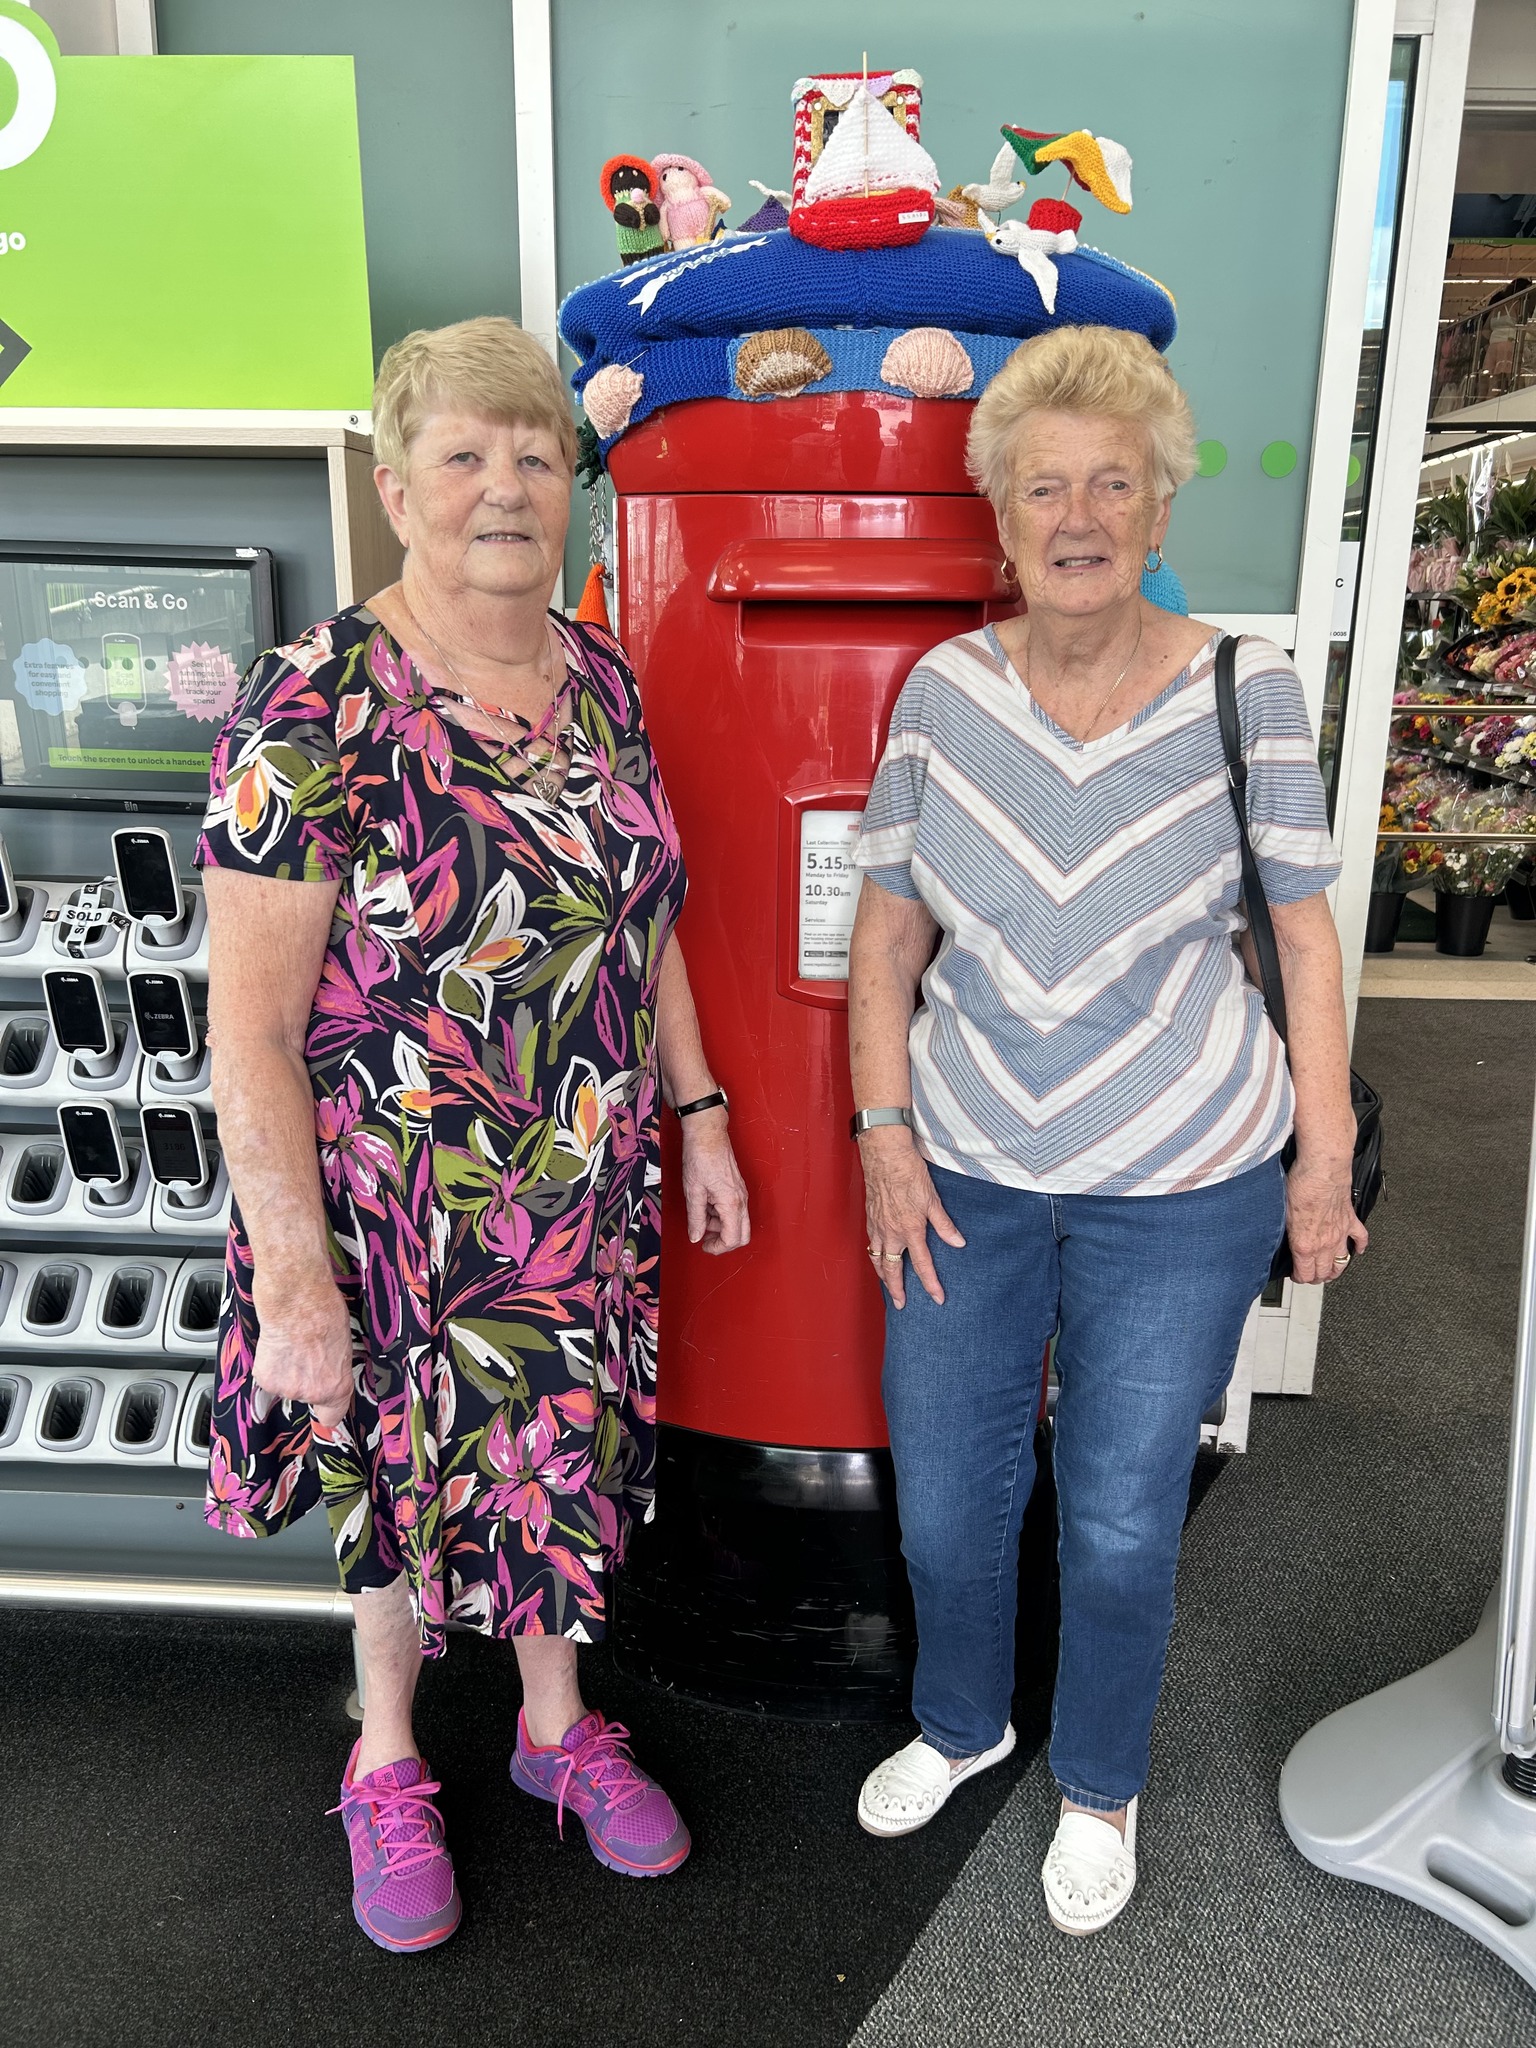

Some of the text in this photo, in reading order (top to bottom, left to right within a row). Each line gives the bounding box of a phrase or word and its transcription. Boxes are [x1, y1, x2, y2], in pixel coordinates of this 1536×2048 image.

[94, 591, 188, 610] Scan & Go
[58, 754, 82, 762] Touch
[83, 755, 97, 763] the
[98, 756, 126, 764] screen
[137, 757, 165, 765] unlock
[172, 758, 206, 766] handset
[807, 853, 856, 871] 5.15pm
[66, 909, 102, 922] SOLD
